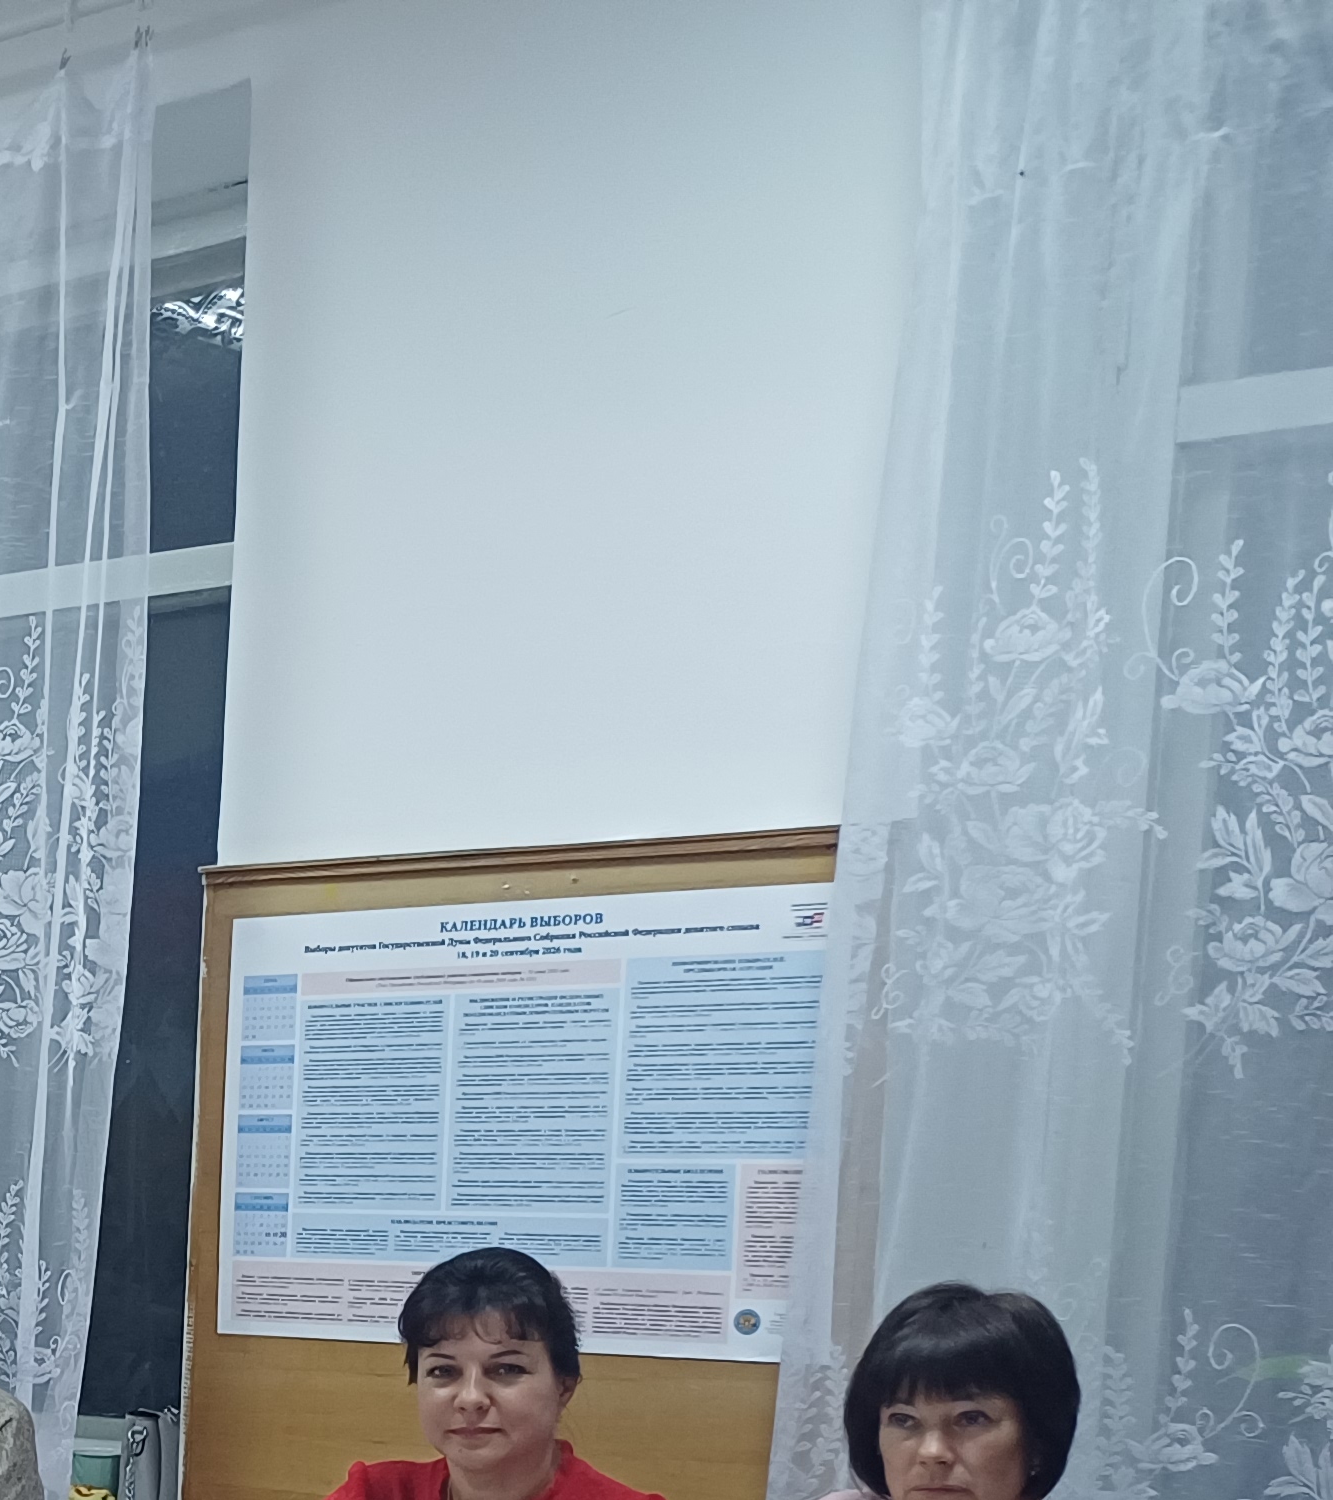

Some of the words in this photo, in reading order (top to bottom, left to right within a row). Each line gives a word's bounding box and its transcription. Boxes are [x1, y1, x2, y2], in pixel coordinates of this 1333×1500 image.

[439, 917, 526, 933] КАЛЕНДАРЬ
[530, 913, 603, 928] ВЫБОРОВ
[488, 949, 499, 958] 20
